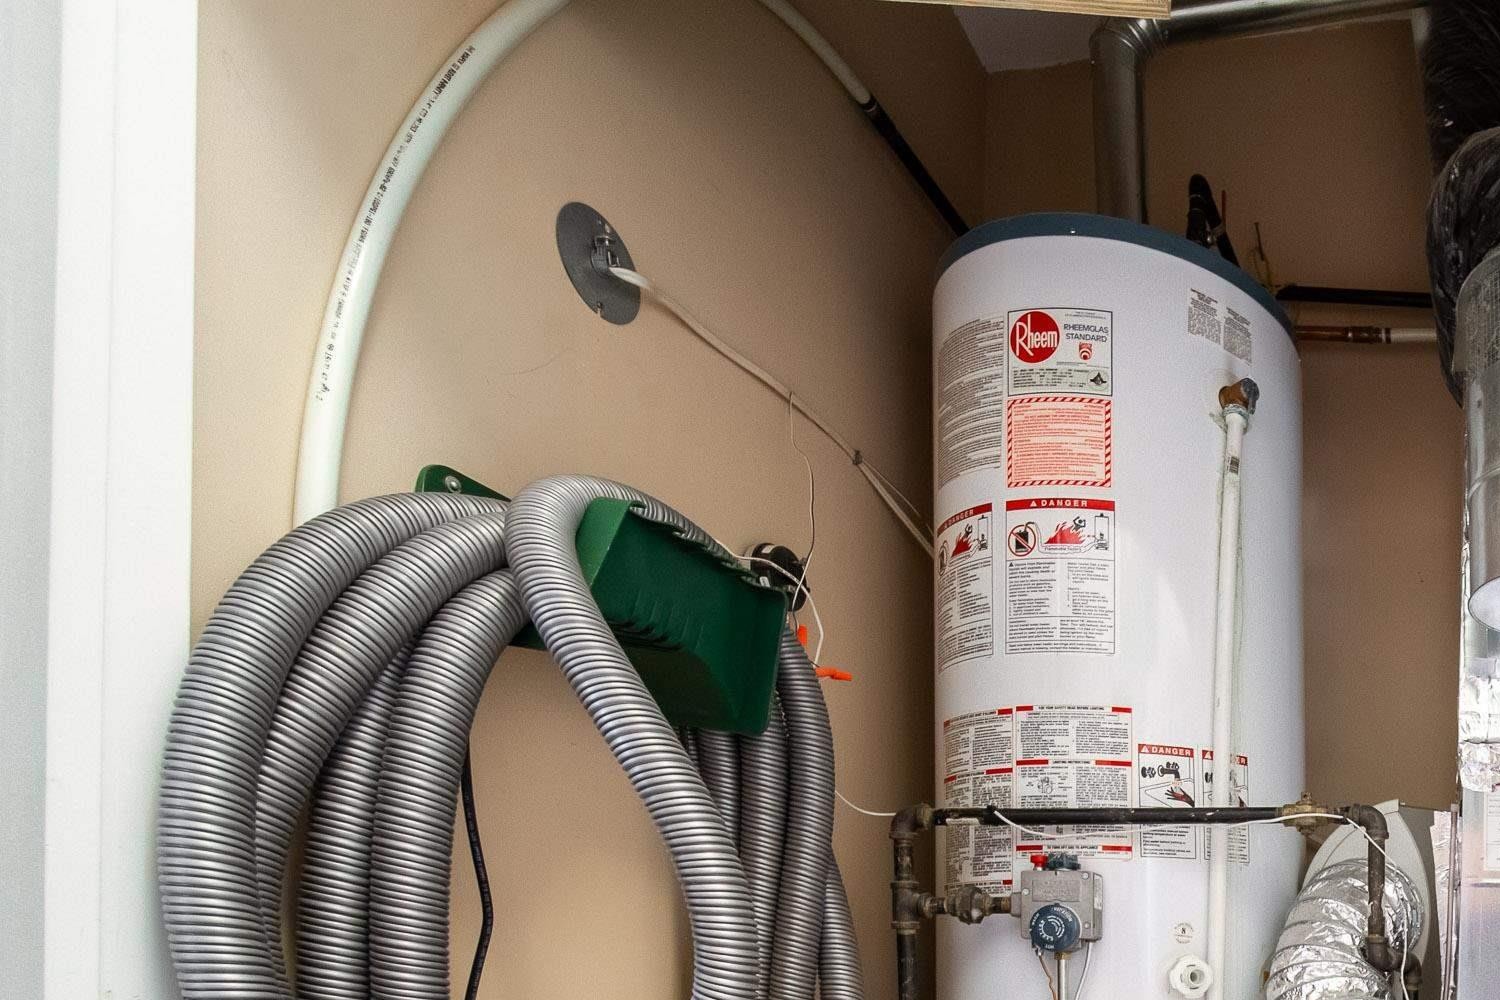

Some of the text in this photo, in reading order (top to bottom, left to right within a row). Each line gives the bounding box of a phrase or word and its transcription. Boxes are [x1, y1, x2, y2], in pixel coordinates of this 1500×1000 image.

[1064, 324, 1108, 333] RHEEMGLAS
[1016, 314, 1057, 357] Rheem
[1066, 333, 1107, 342] STANDARD
[1152, 746, 1191, 755] DANGER
